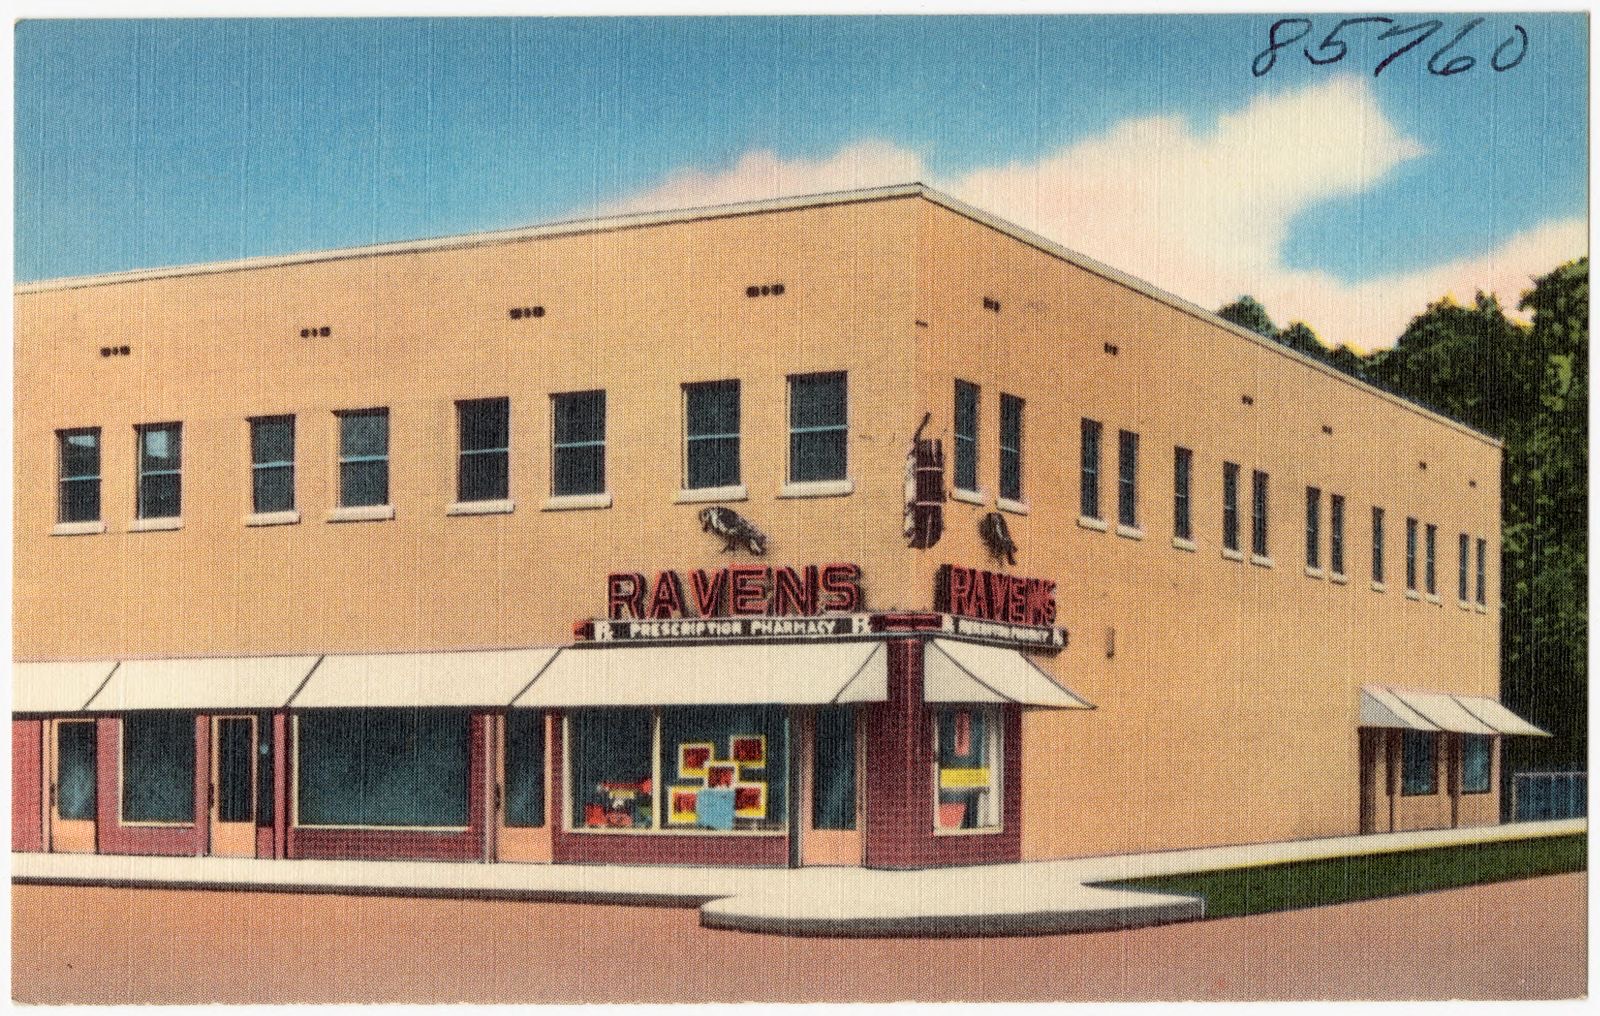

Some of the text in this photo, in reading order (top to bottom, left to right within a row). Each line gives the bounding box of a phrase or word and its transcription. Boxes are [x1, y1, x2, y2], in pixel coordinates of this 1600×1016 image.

[1251, 16, 1530, 77] 85760
[608, 563, 862, 620] RAVENS
[629, 621, 743, 638] PRESCRIPTION
[750, 618, 836, 636] PHARMACY
